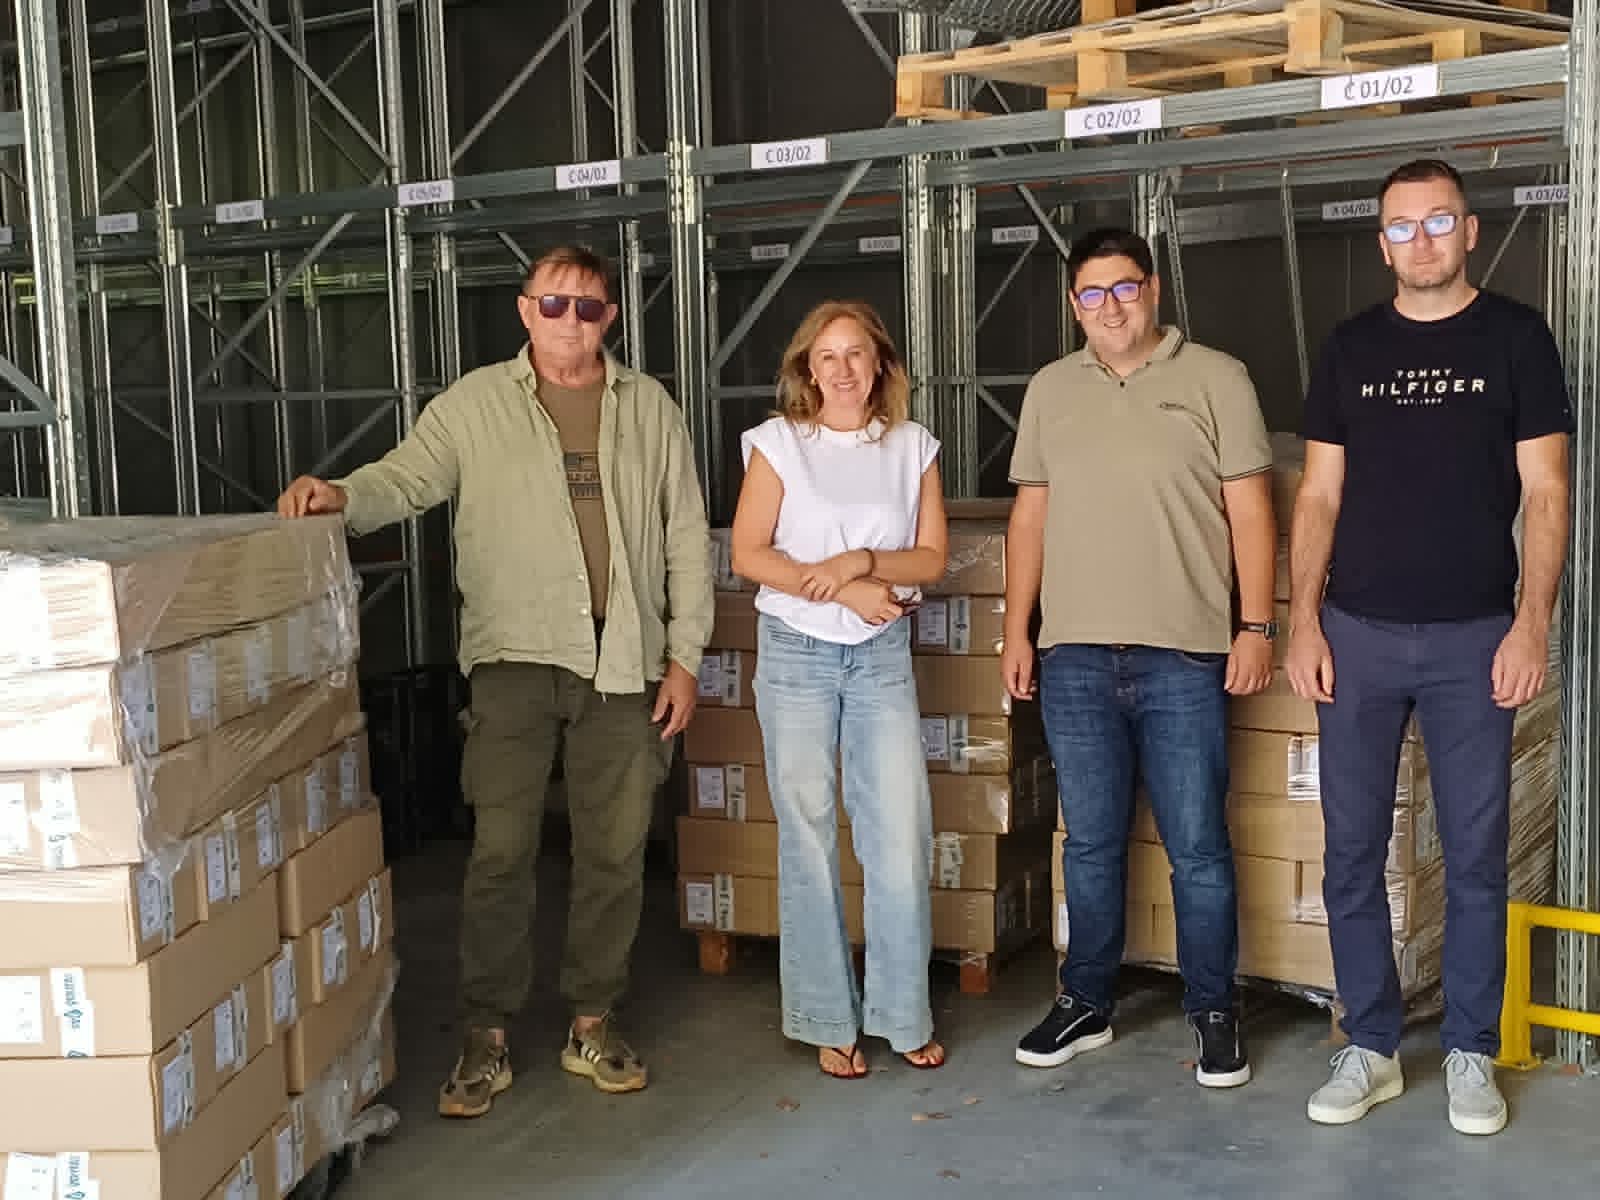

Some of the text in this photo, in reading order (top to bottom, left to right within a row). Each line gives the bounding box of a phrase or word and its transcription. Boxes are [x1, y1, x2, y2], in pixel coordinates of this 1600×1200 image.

[1344, 75, 1413, 99] C 01/02
[1083, 107, 1141, 129] C 02/02
[765, 145, 811, 163] C 03/02
[1396, 368, 1452, 379] TOMMY
[1361, 378, 1486, 397] HILFIGER
